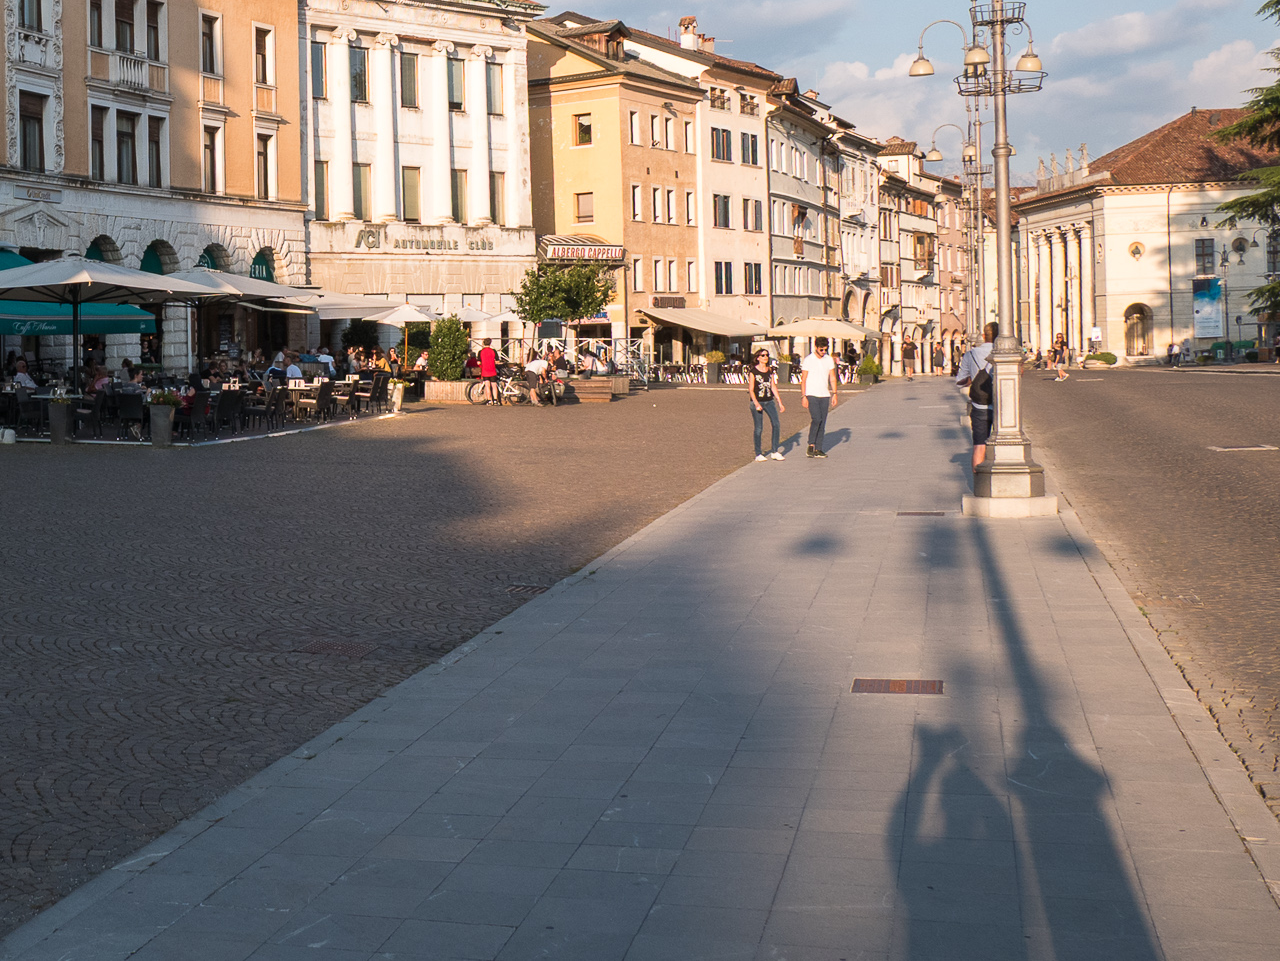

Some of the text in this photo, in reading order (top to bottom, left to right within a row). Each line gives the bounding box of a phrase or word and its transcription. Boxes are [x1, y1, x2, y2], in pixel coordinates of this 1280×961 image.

[354, 229, 494, 251] ACI AUTOMOBILE CLUB
[551, 246, 623, 259] ALBERGO CAPPELLO
